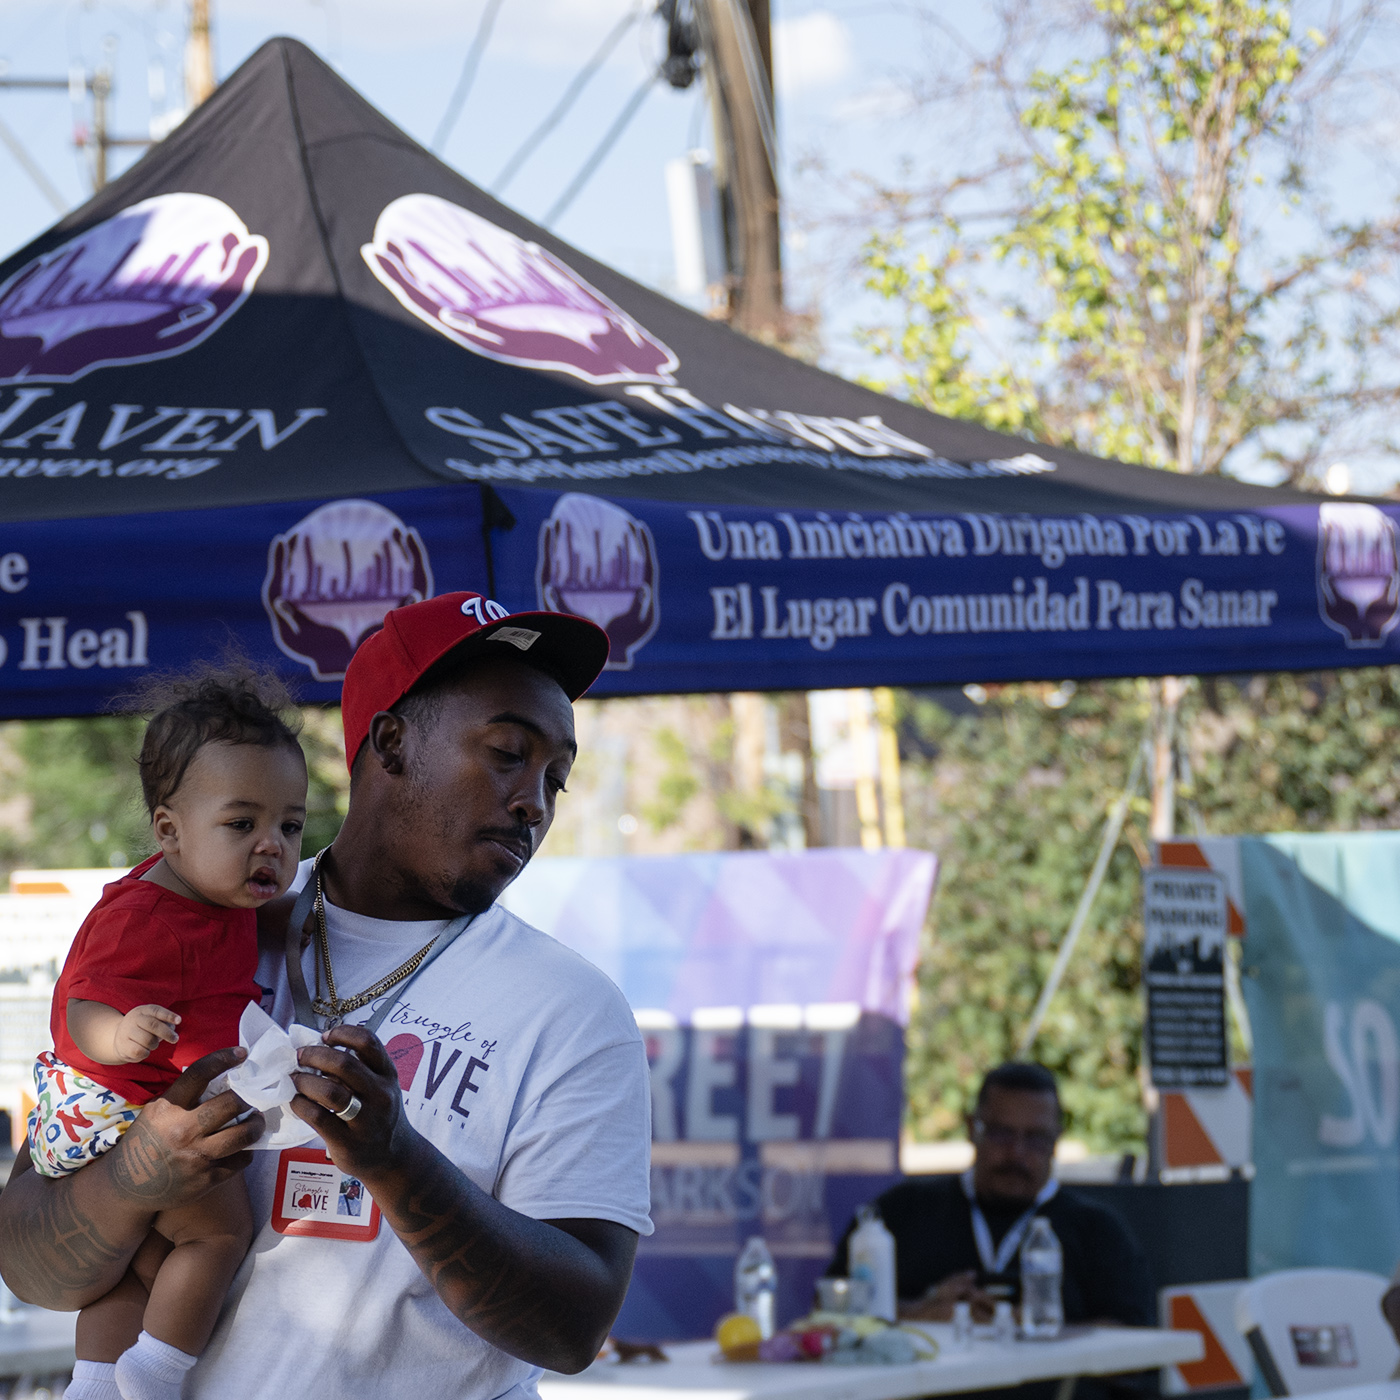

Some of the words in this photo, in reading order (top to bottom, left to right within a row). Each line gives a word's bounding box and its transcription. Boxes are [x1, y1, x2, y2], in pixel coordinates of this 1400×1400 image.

[688, 509, 784, 561] Una
[774, 510, 969, 559] Iniciativa
[1120, 513, 1193, 556] Por
[1185, 513, 1242, 556] La
[19, 611, 150, 670] Heal
[710, 582, 755, 640] El
[760, 584, 879, 651] Lugar
[882, 577, 1091, 636] Comunidad
[1096, 580, 1177, 631] Para
[1179, 577, 1279, 629] Sanar
[480, 1039, 498, 1061] of
